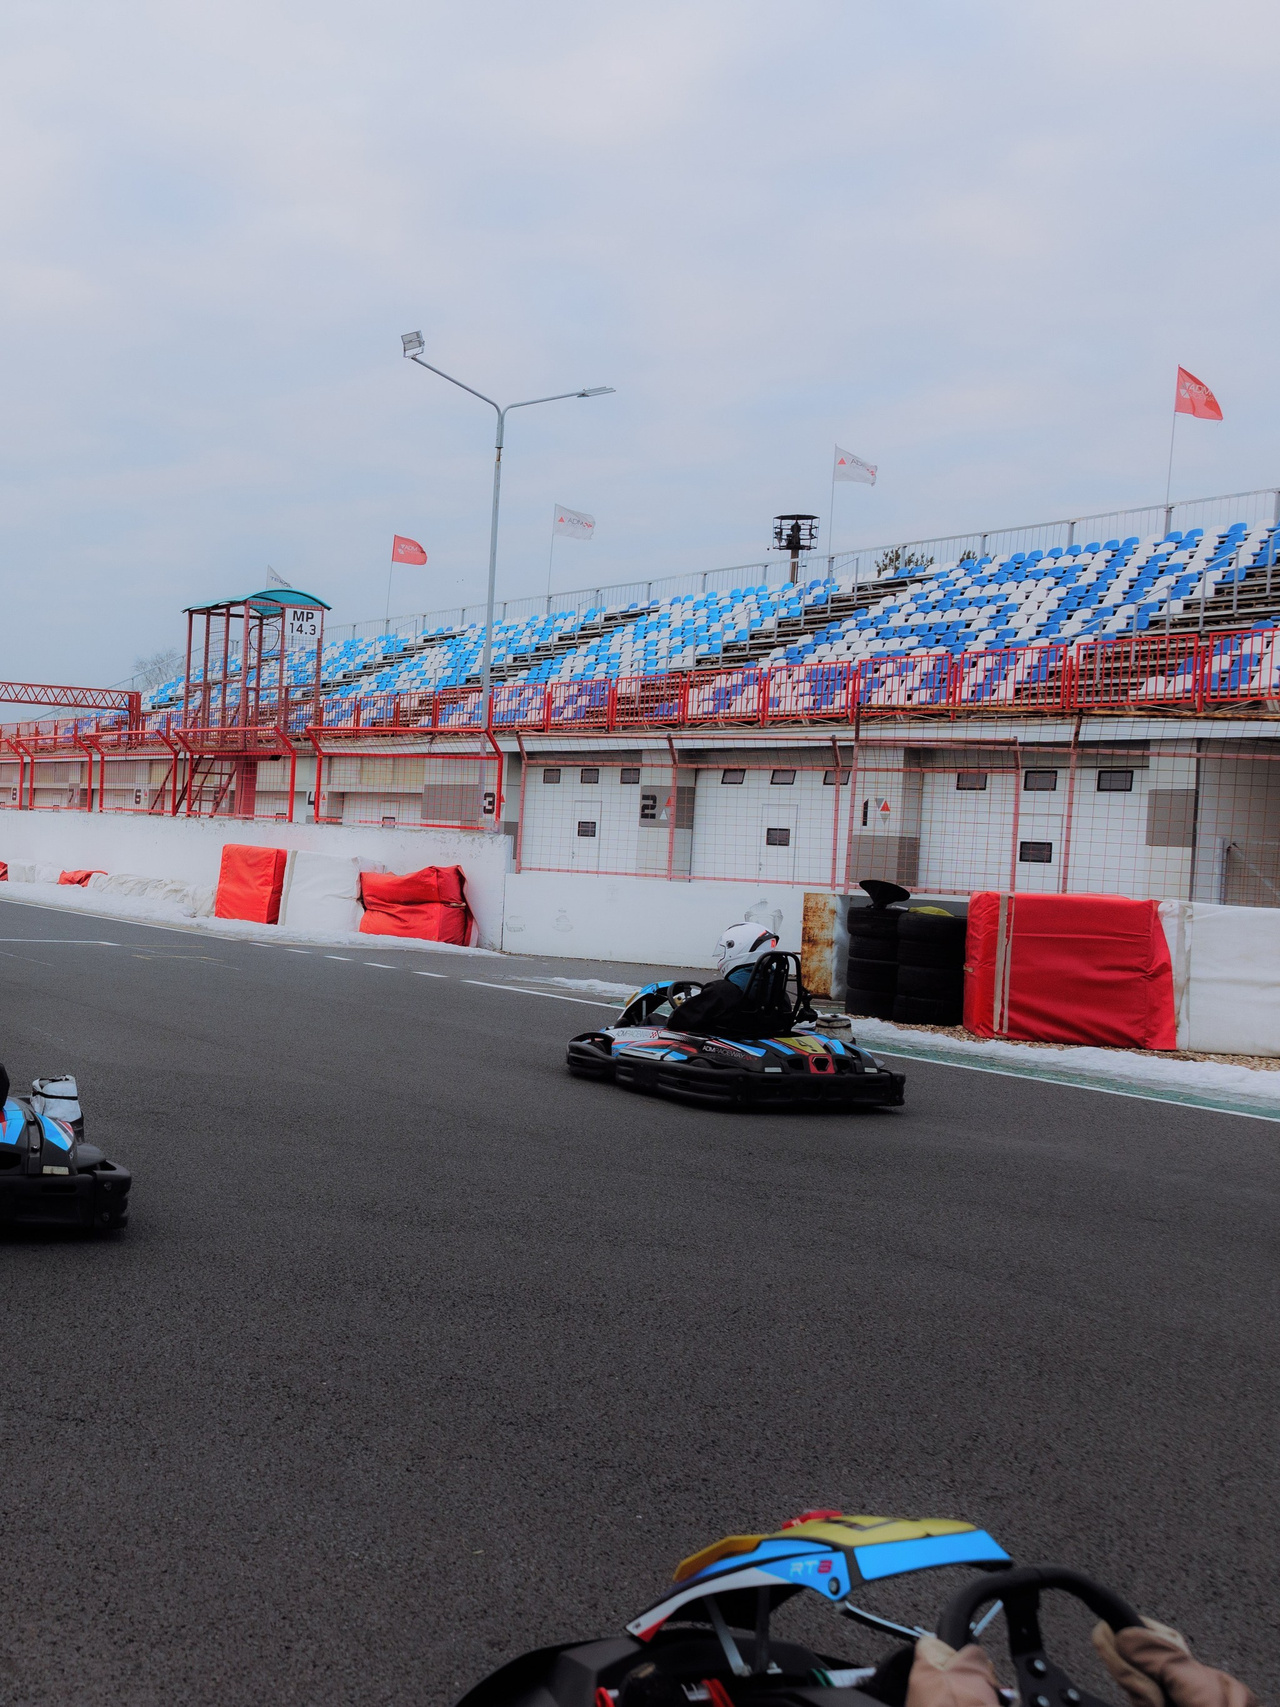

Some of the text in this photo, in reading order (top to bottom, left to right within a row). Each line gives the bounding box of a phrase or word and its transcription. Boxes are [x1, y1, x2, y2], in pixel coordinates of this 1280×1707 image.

[293, 610, 315, 622] MP
[289, 622, 317, 635] 14.3
[68, 788, 75, 803] 7
[135, 788, 142, 804] 6
[483, 792, 496, 815] 3
[640, 794, 657, 820] 2
[862, 797, 870, 827] 1
